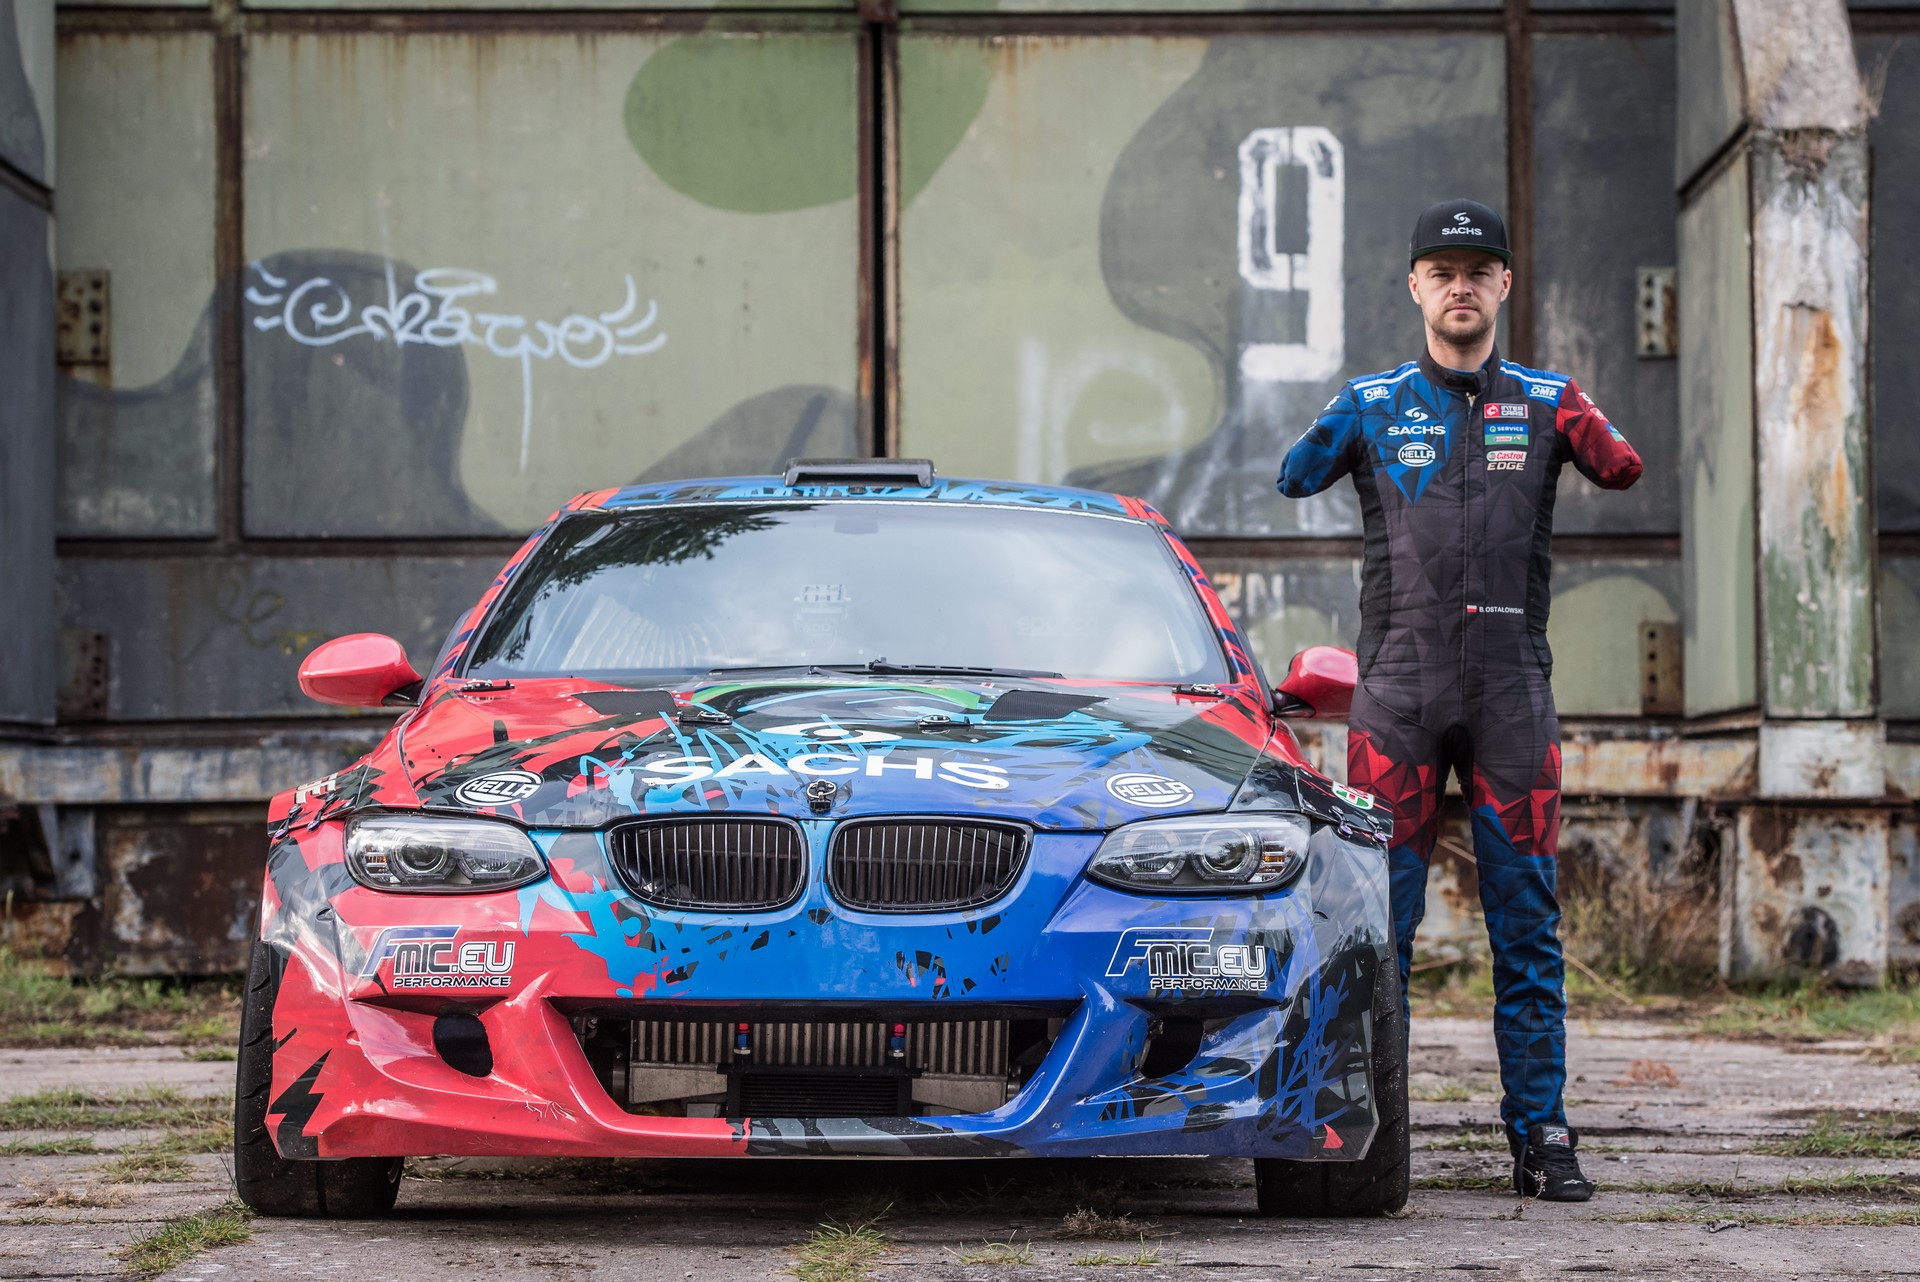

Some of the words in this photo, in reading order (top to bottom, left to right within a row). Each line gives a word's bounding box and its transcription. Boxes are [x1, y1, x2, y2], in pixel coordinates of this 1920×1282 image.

[1441, 226, 1483, 236] SACHS
[1237, 126, 1345, 382] 9
[1363, 387, 1389, 399] OMP
[1530, 386, 1557, 397] OMP
[1387, 425, 1447, 436] SACHS
[1401, 450, 1436, 460] HELLA
[1496, 451, 1524, 460] Castrol
[1486, 462, 1526, 471] EDGE
[641, 753, 1010, 790] SACHS
[464, 780, 541, 799] HELLA
[1114, 782, 1194, 797] HELLA
[393, 976, 511, 988] PERFORMANCE
[1150, 978, 1268, 991] PERFORMANCE
